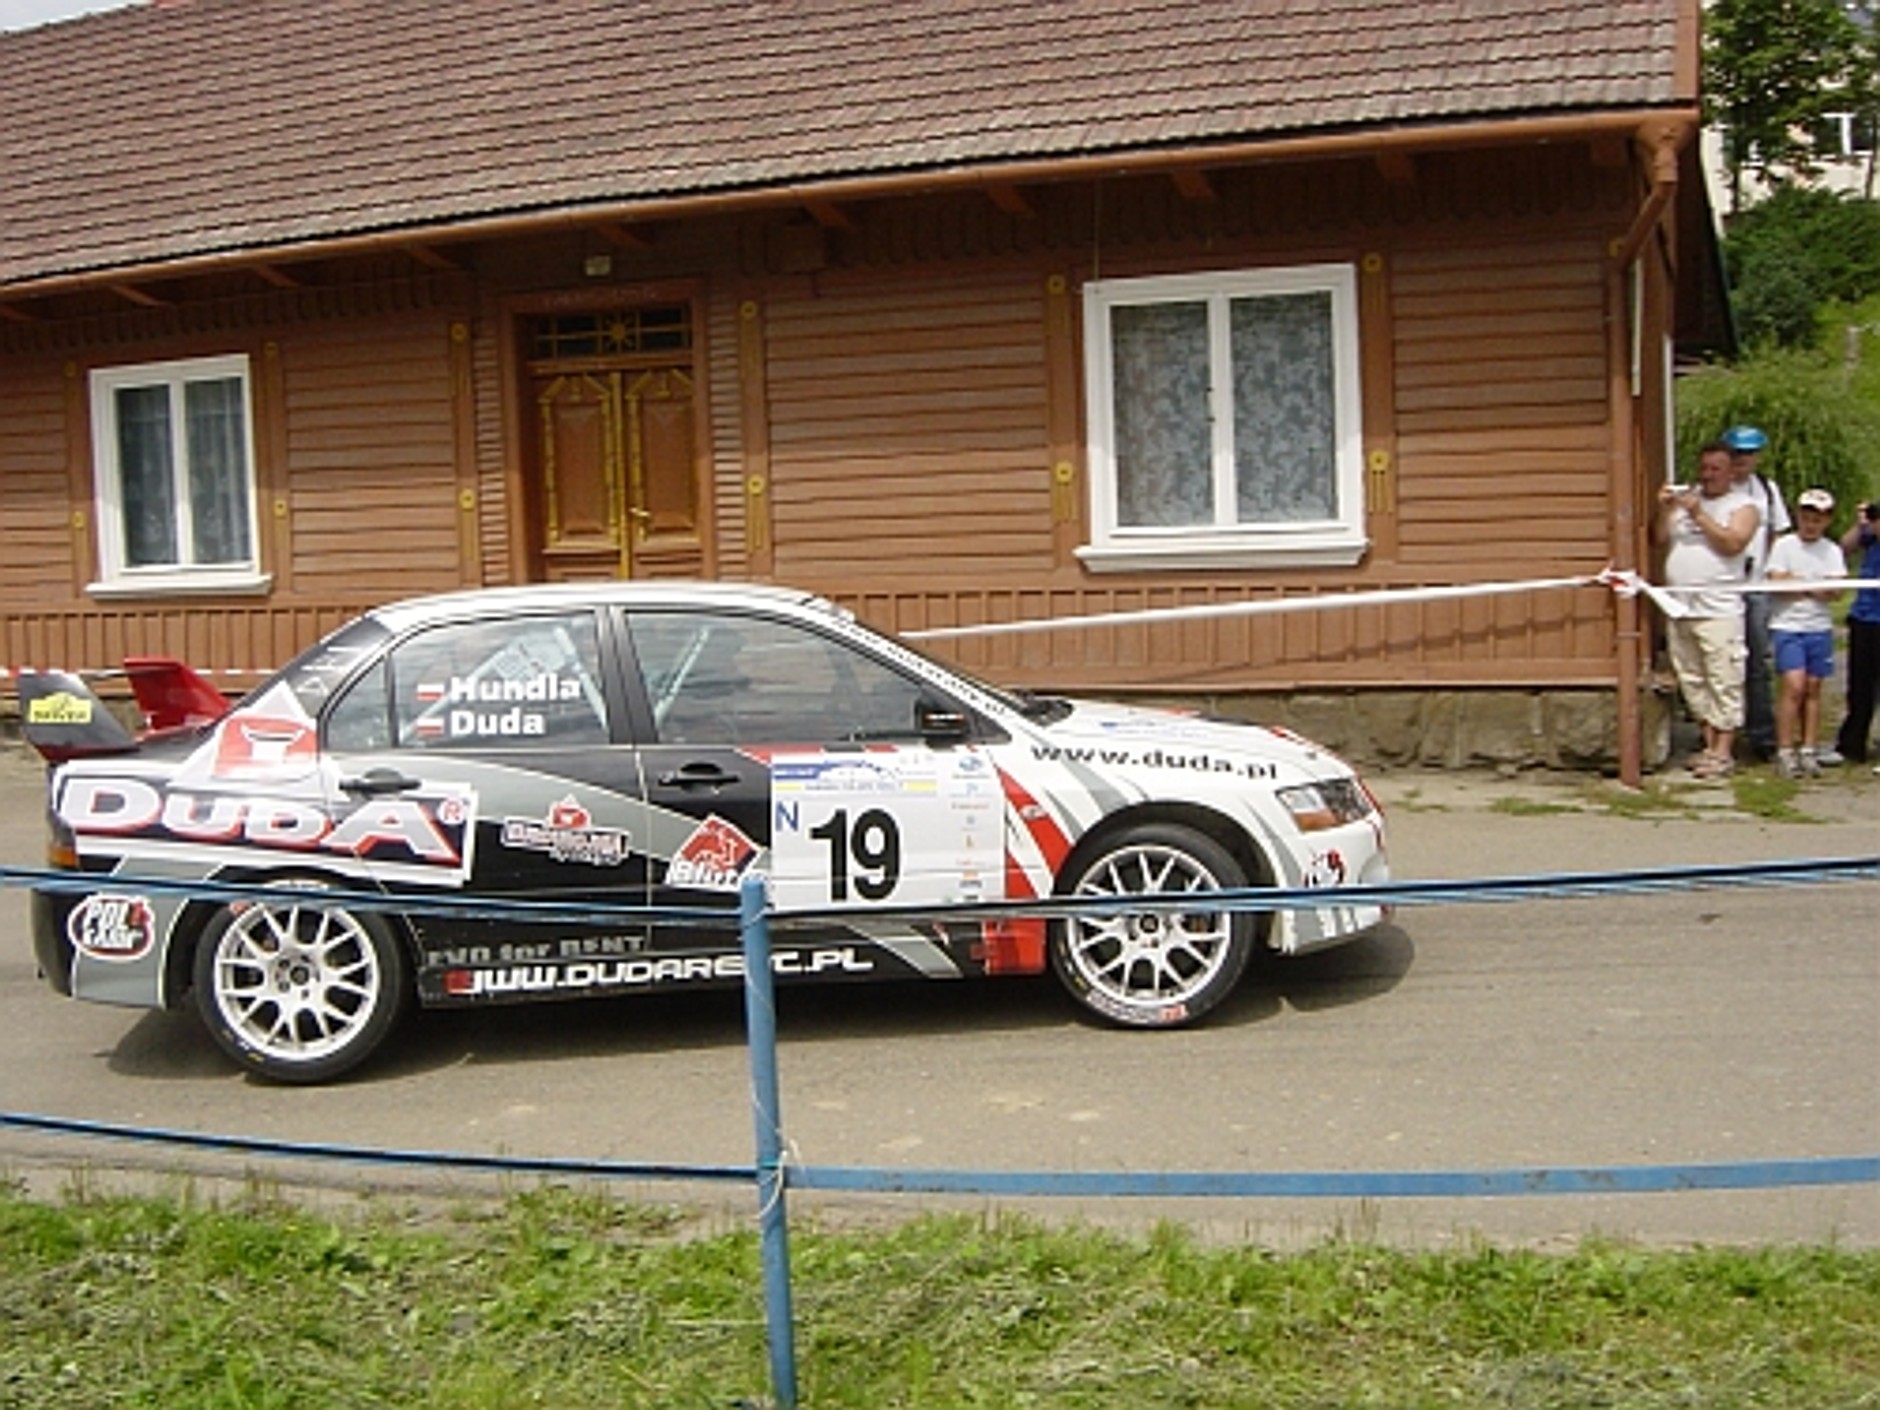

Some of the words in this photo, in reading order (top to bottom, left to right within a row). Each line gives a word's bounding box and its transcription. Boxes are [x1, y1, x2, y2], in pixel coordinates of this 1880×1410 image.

[451, 673, 581, 701] Hundla
[451, 707, 545, 736] Duda
[1031, 746, 1277, 780] www.duda.pl
[60, 778, 461, 865] DUDA
[775, 800, 799, 832] N
[810, 808, 901, 902] 19
